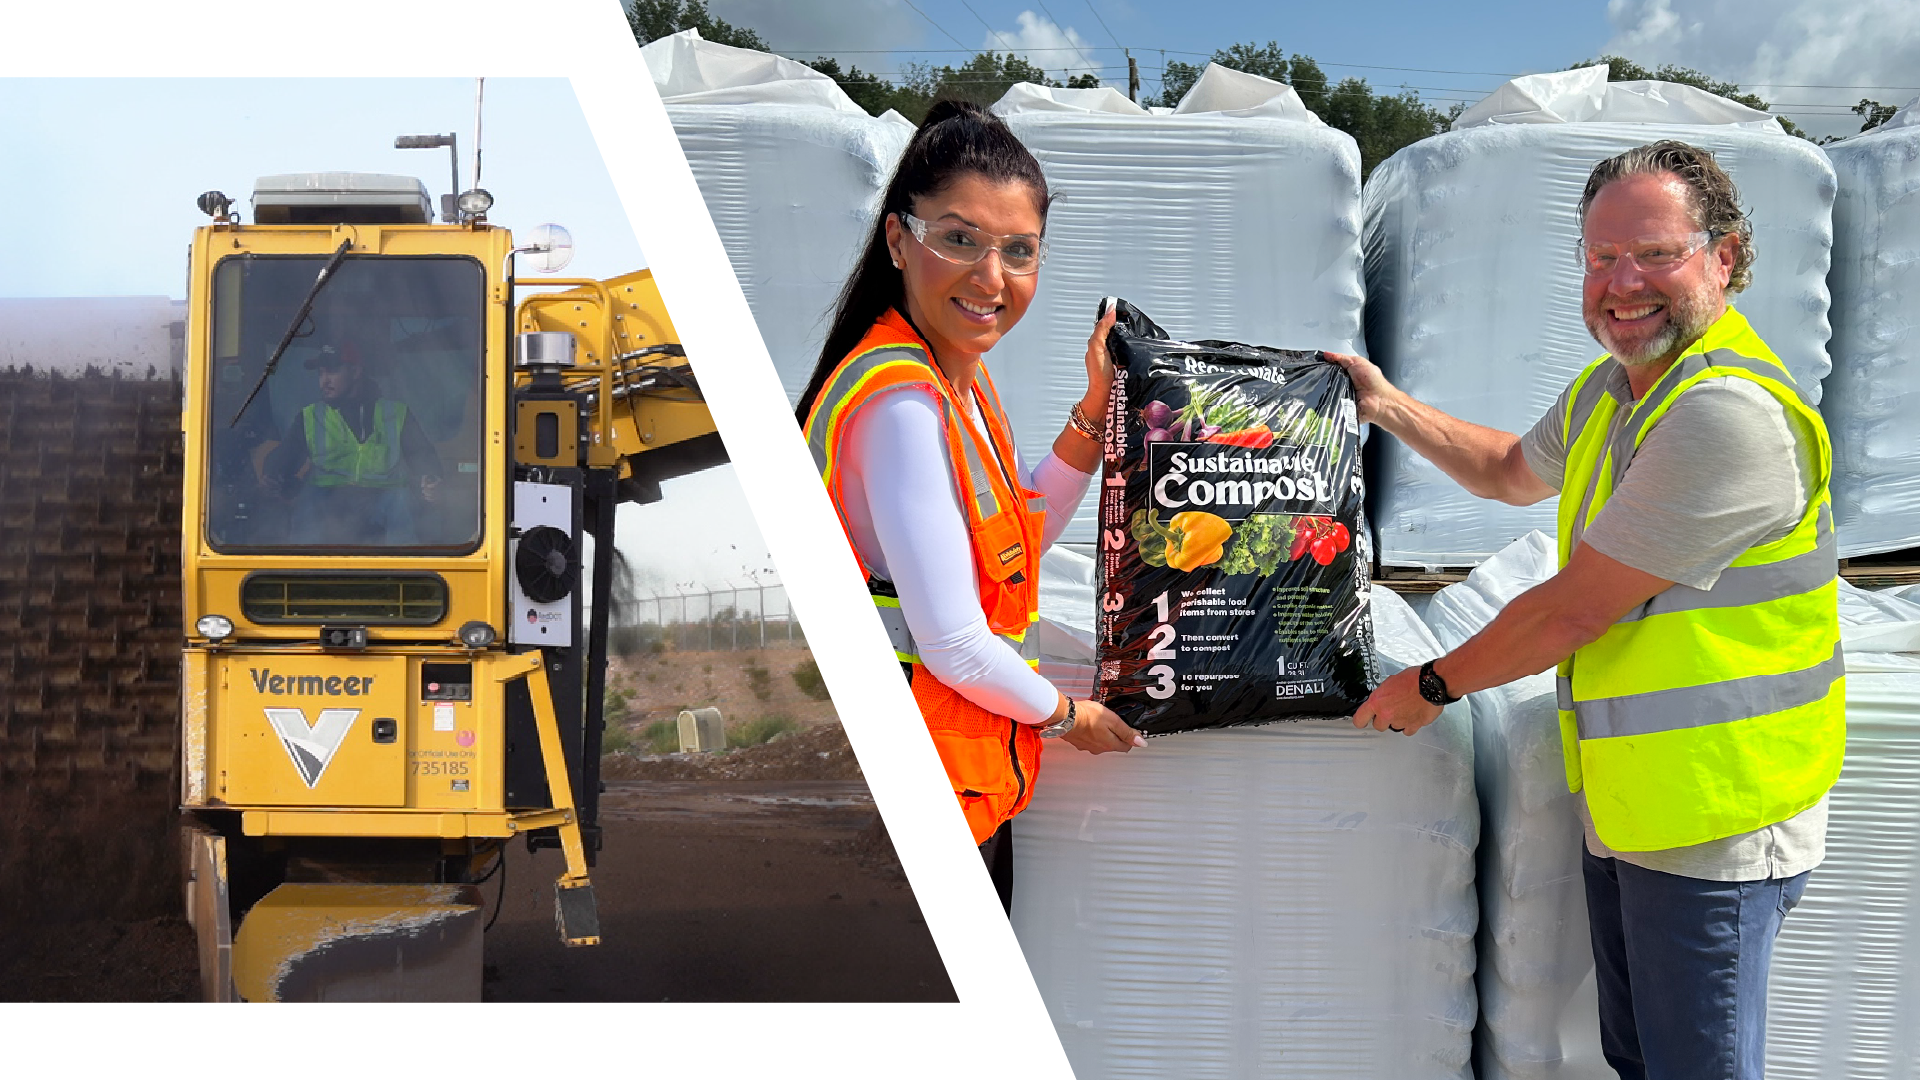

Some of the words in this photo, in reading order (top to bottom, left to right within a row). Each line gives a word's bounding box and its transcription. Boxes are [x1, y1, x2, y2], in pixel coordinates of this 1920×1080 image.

[1185, 355, 1287, 385] Reculate
[1116, 369, 1129, 457] Sustainable
[1106, 472, 1126, 487] 1
[1154, 471, 1333, 509] Compost
[1103, 529, 1126, 551] 2
[1196, 587, 1226, 595] collect
[1103, 592, 1125, 613] 3
[1151, 590, 1169, 623] 1
[1180, 609, 1205, 617] items
[1207, 608, 1228, 616] from
[1181, 598, 1226, 608] perishable
[1229, 598, 1247, 606] food
[1147, 624, 1176, 660] 2
[1193, 644, 1231, 653] compost
[1276, 655, 1285, 676] 1
[1287, 662, 1298, 670] CU
[249, 667, 375, 696] Vermeer
[1145, 664, 1176, 700] 3
[1196, 684, 1213, 692] you
[1276, 682, 1325, 696] DENALI
[460, 750, 476, 760] Only
[411, 761, 469, 776] 735185
